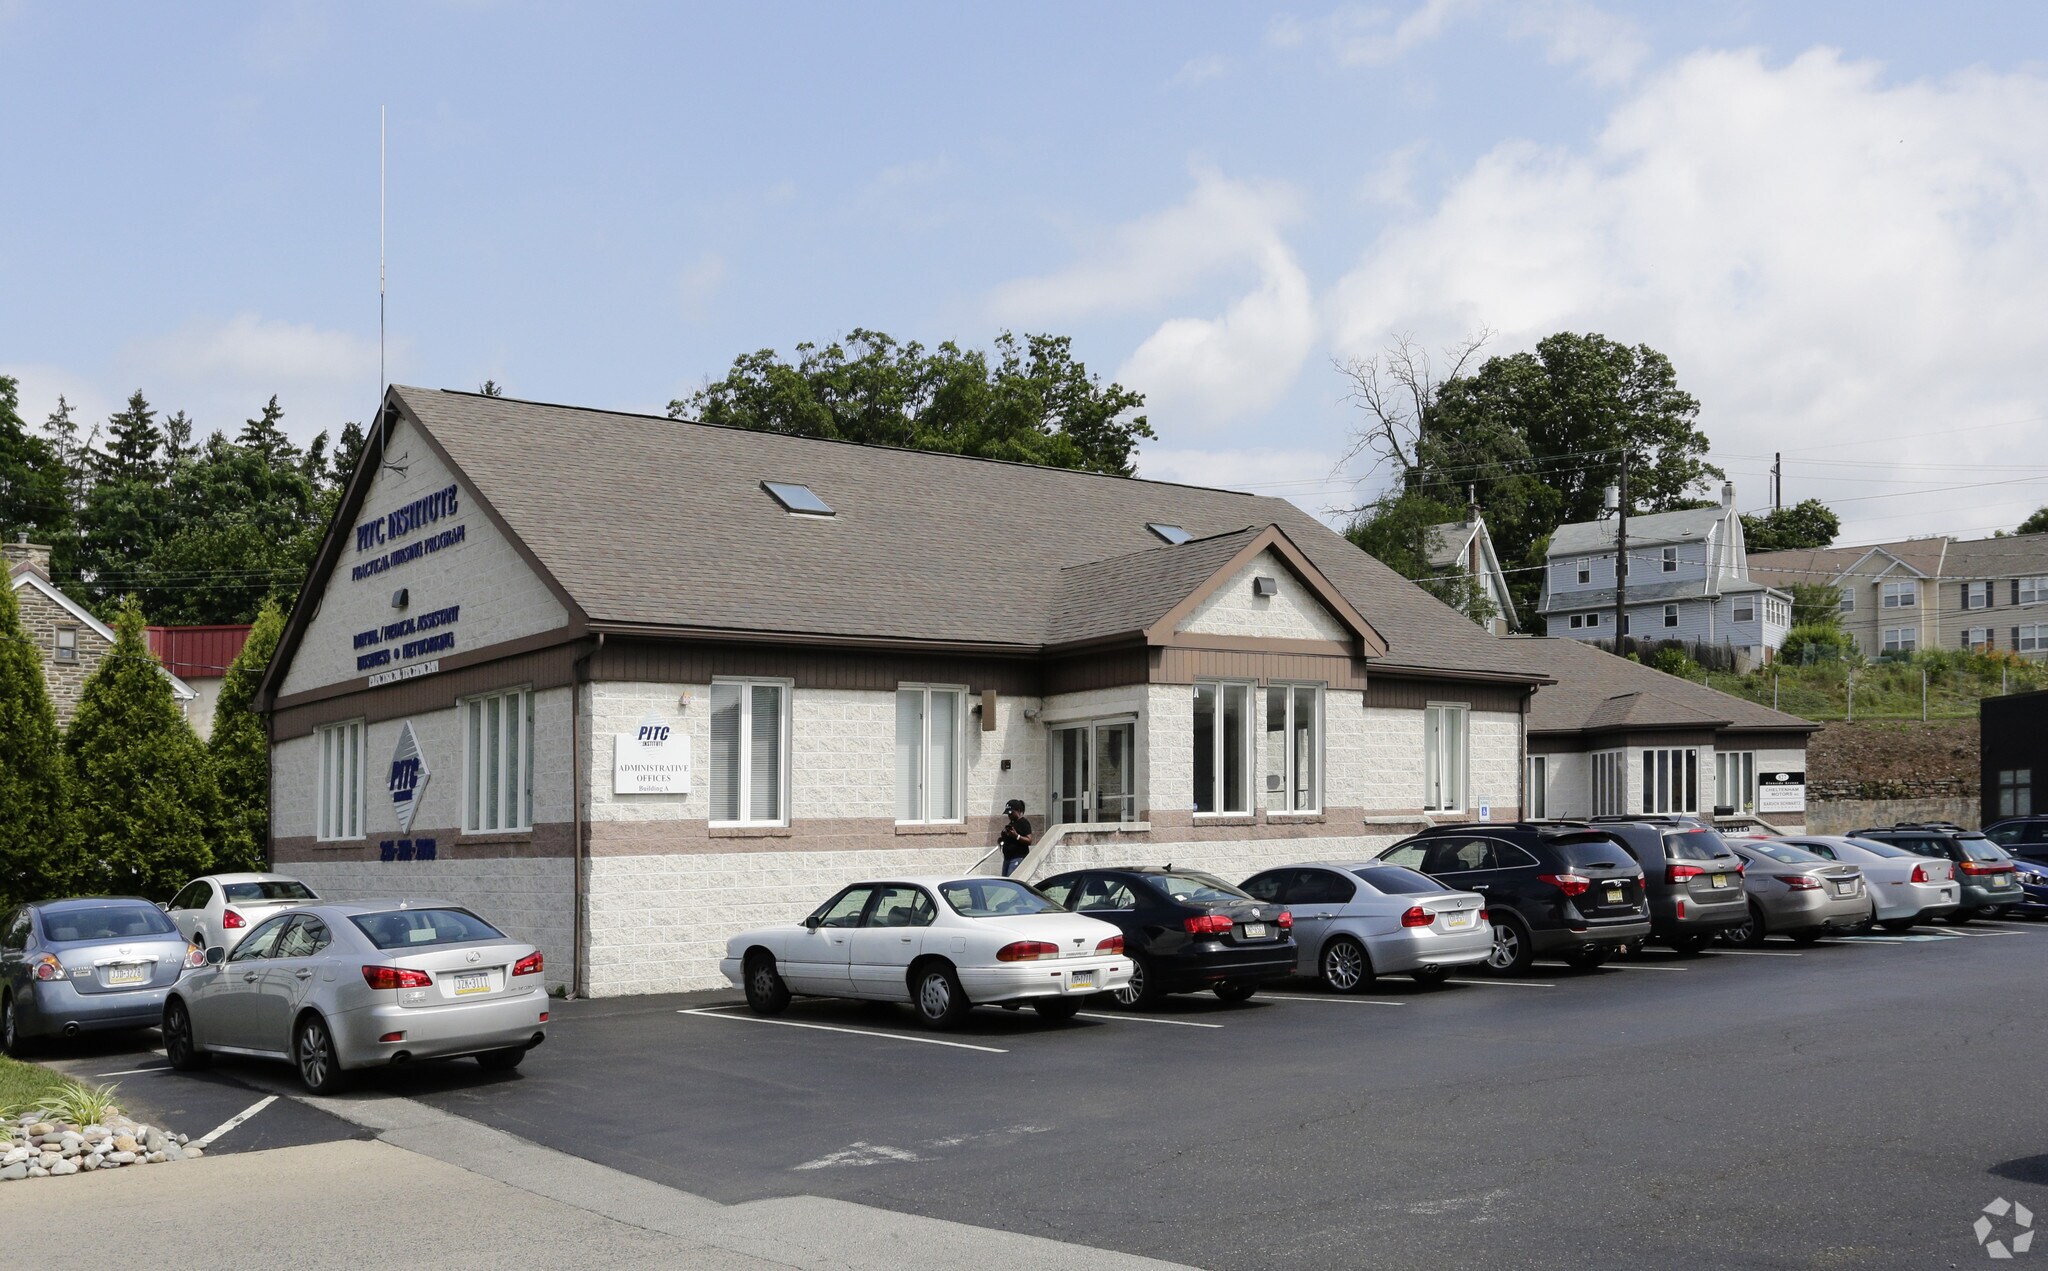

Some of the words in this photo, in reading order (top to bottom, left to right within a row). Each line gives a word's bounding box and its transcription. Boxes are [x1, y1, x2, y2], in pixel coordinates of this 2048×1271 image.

[357, 516, 385, 552] PITC
[388, 484, 459, 540] INSTITUTE
[352, 555, 390, 581] PRACTICAL
[391, 541, 423, 567] NURSING
[424, 525, 465, 554] PROGRAM
[384, 618, 416, 640] MEDICAL
[417, 605, 460, 631] ASSISTANT
[403, 632, 455, 659] NETWORKING
[1194, 687, 1199, 698] A
[638, 726, 670, 740] PITC
[389, 757, 419, 791] PITC
[618, 764, 689, 772] ADMINISTRATIVE
[636, 774, 671, 782] OFFICES
